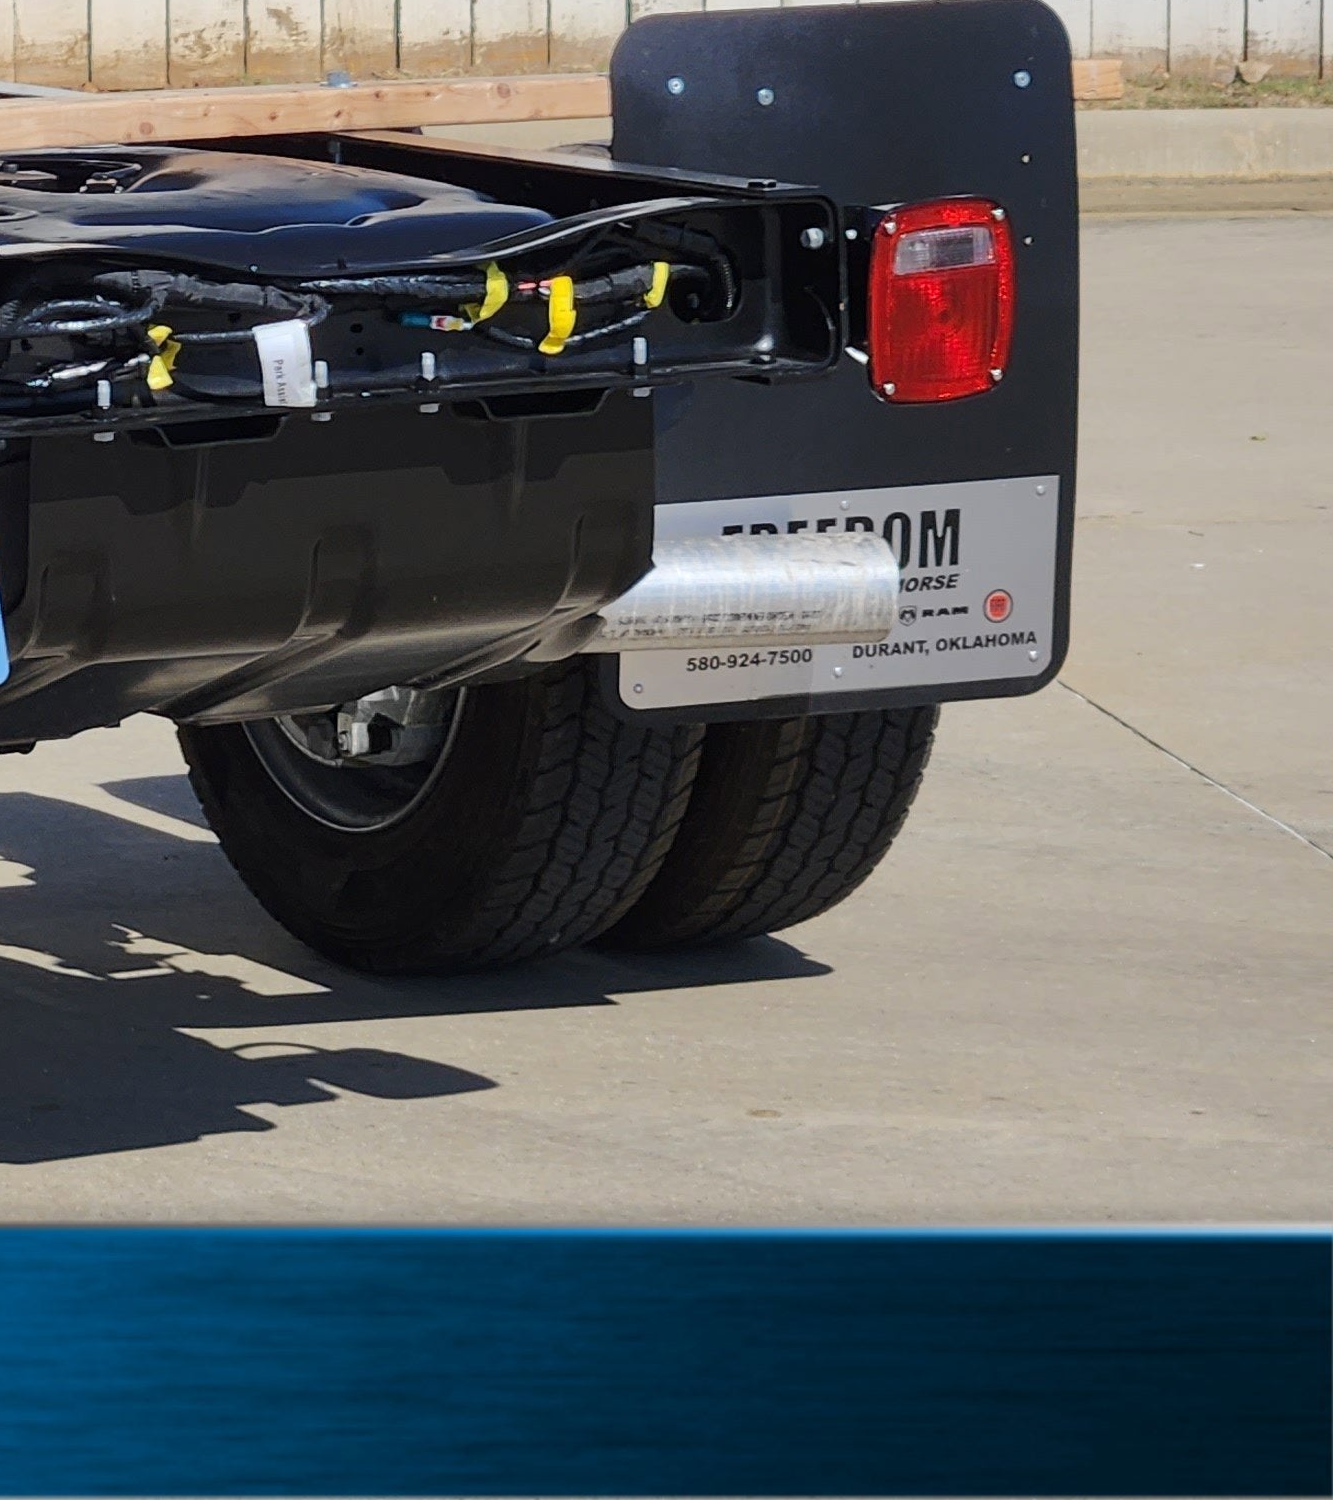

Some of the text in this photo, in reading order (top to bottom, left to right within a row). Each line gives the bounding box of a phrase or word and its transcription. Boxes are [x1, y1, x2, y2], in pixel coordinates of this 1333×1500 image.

[921, 605, 969, 618] RAM
[852, 631, 1038, 660] DURANT, OKLAHOMA
[686, 648, 813, 672] 580-924-7500
